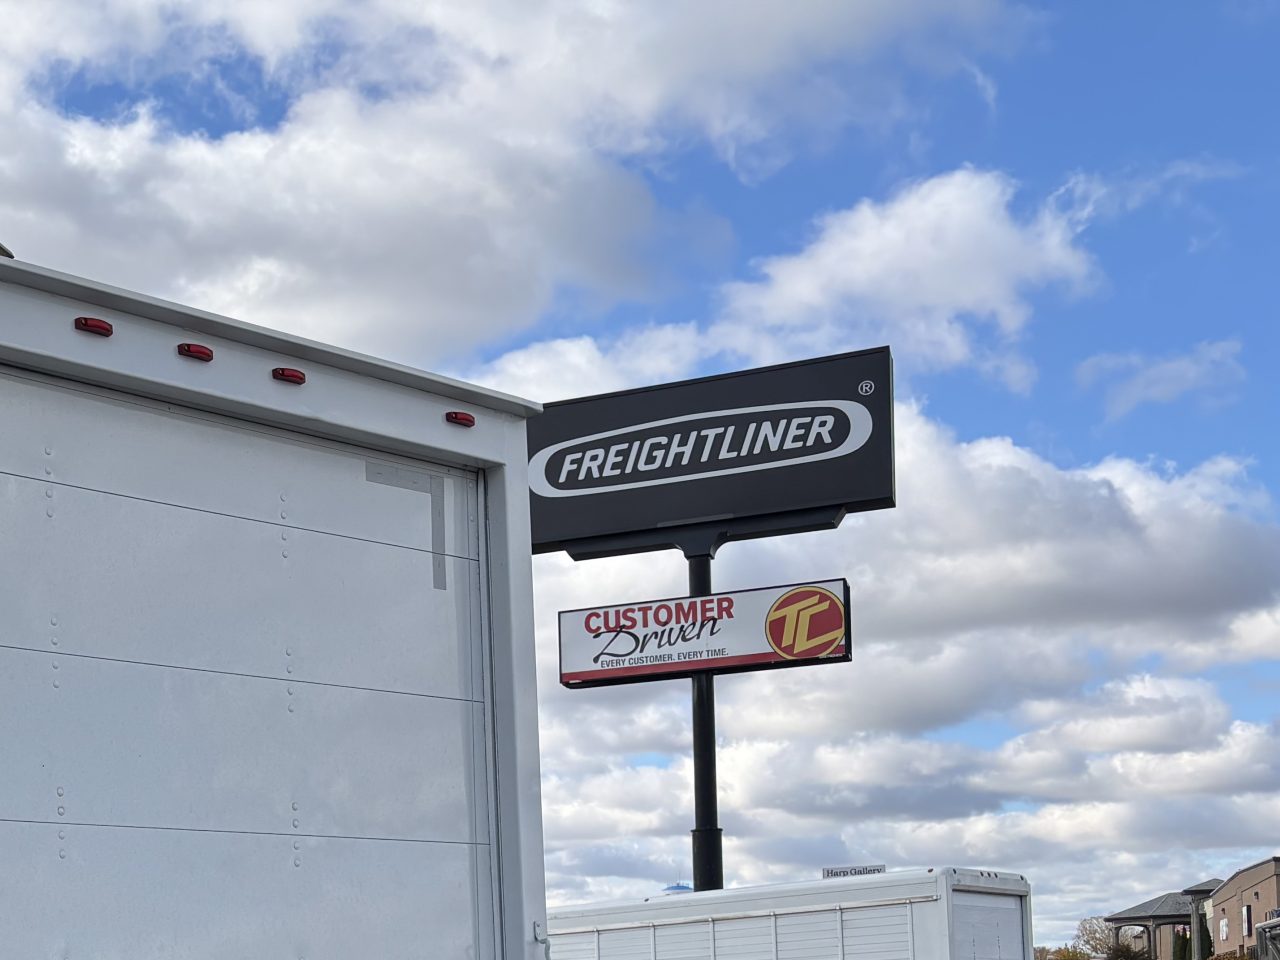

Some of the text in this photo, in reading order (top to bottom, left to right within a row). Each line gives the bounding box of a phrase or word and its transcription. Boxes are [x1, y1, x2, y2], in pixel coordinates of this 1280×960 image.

[557, 414, 836, 484] FREIGHTLINER
[583, 596, 735, 634] CUSTOMER
[768, 593, 845, 655] TC
[592, 615, 723, 664] Driven
[600, 647, 729, 669] EVERY CUSTOMER. EVERY TIME.
[826, 866, 882, 877] Harp Gallery
